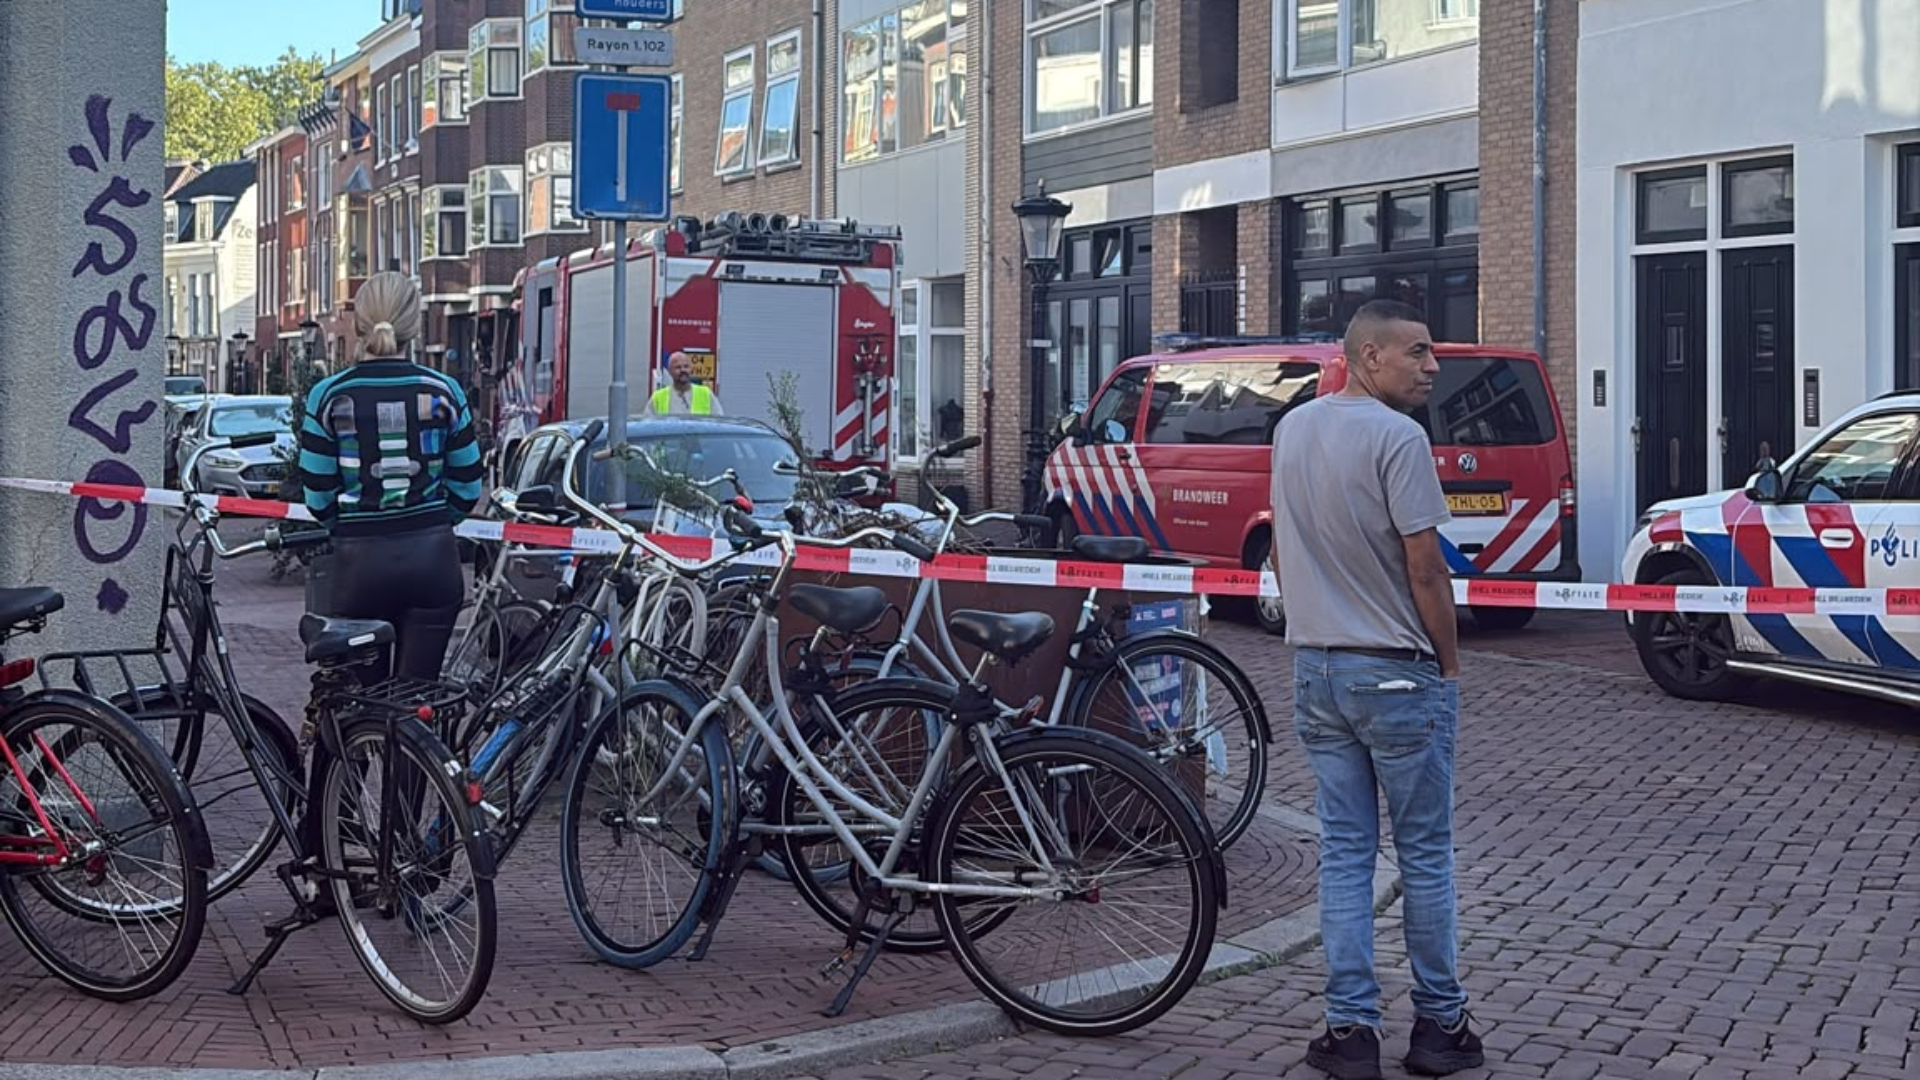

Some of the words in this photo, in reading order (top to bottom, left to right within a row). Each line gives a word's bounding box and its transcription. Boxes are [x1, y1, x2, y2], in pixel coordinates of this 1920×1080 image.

[587, 38, 629, 52] Rayon
[634, 40, 666, 52] 1.102
[1172, 488, 1229, 505] BRANDWEER
